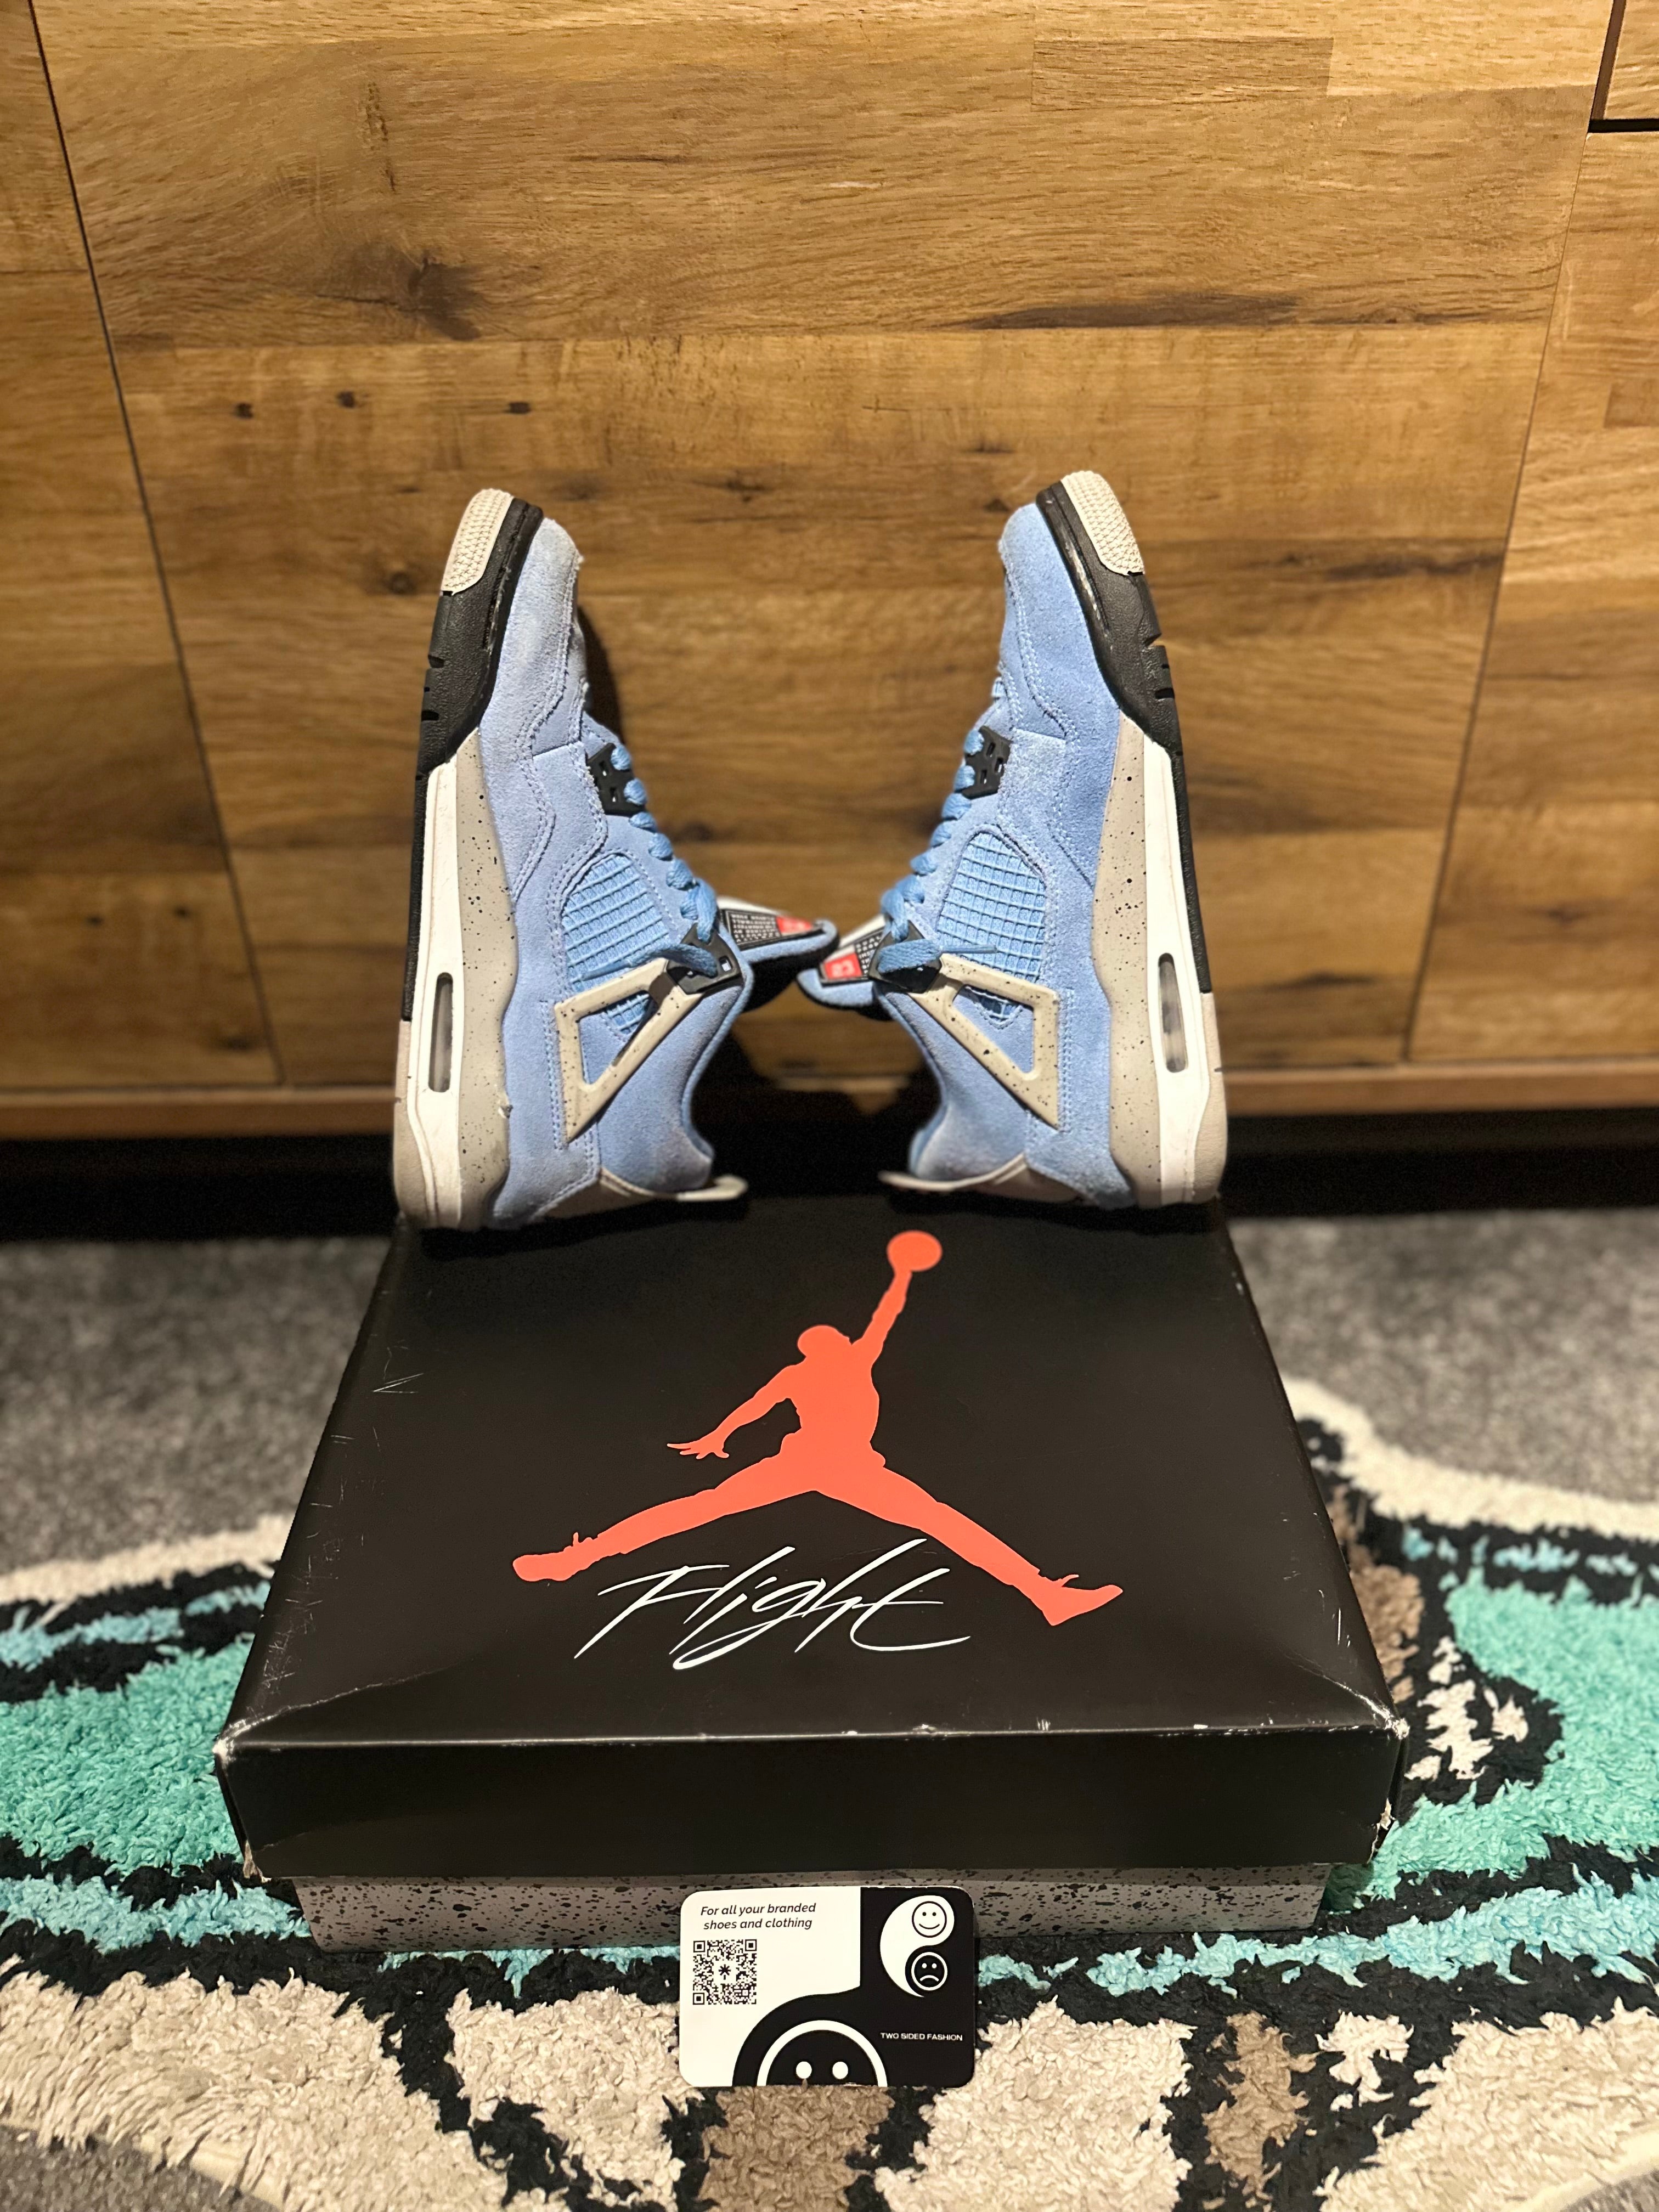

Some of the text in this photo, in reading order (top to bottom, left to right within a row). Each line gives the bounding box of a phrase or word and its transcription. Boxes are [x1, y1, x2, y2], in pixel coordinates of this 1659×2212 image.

[574, 1539, 970, 1669] Flight
[701, 1903, 816, 1917] For all your branded
[703, 1917, 812, 1930] shoes and clothing
[927, 2033, 963, 2041] FASHION
